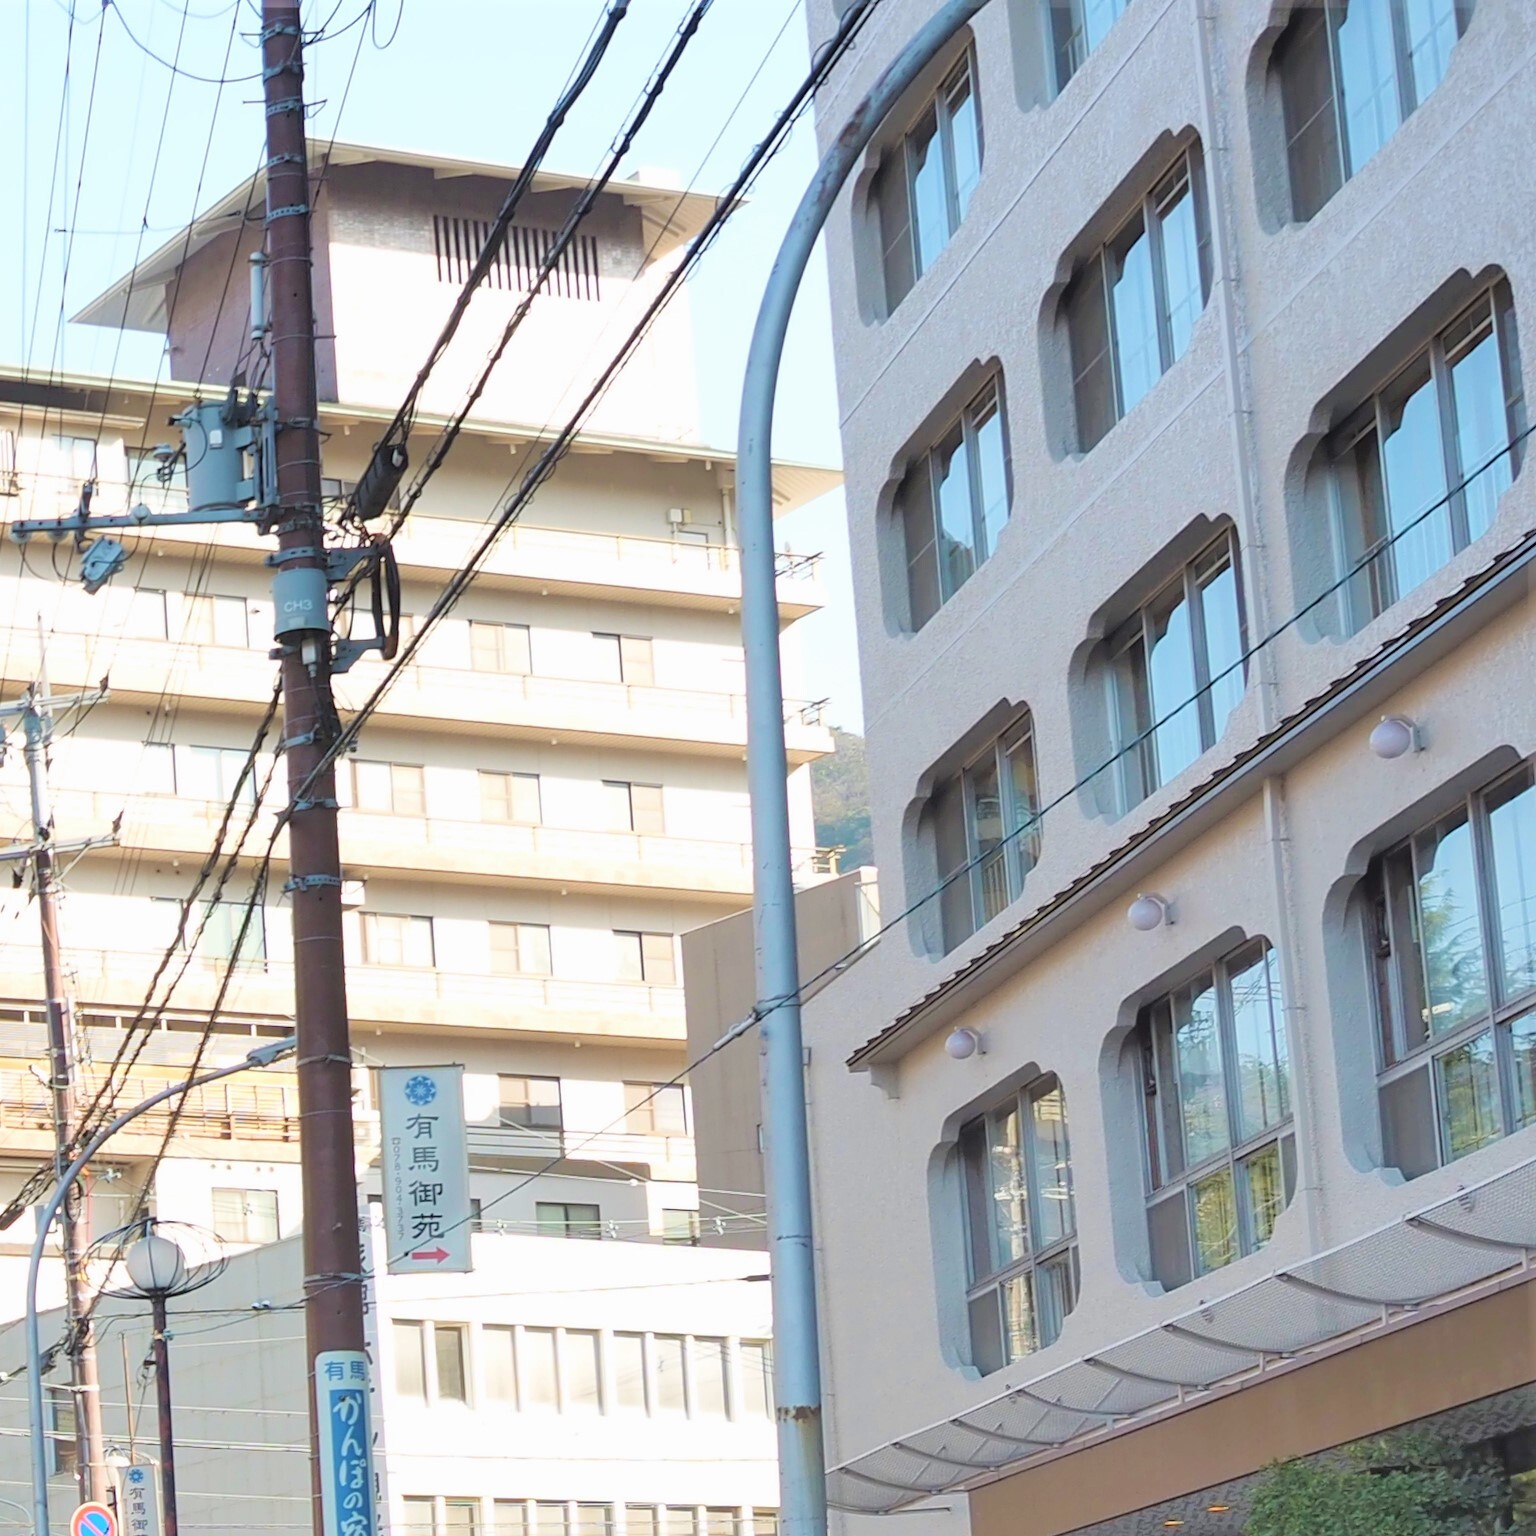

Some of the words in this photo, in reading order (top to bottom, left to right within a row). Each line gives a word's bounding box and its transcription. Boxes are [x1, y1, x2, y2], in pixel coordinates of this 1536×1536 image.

[283, 599, 314, 613] CH3
[405, 1113, 445, 1239] 有馬御苑
[323, 1360, 367, 1382] 有馬
